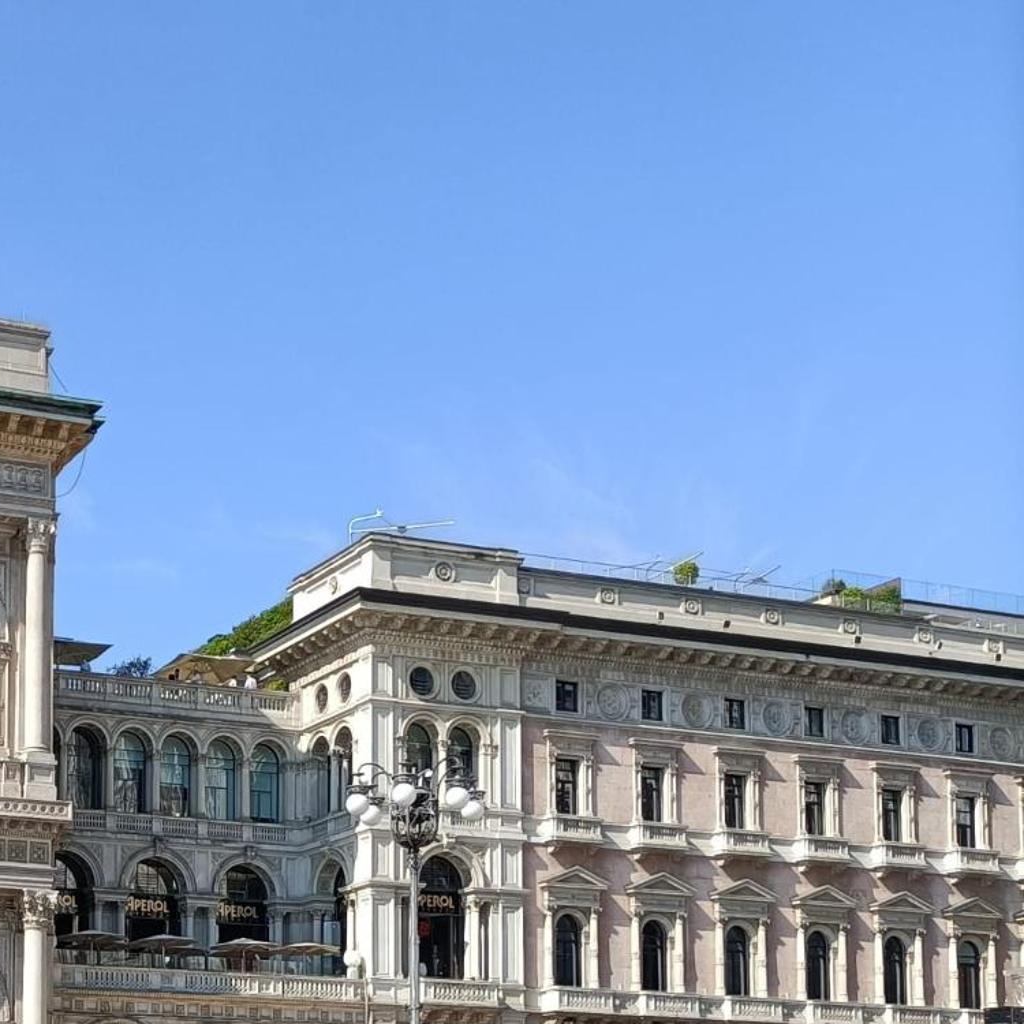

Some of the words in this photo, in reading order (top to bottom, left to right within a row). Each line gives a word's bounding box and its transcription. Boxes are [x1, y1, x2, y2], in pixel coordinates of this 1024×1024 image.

[126, 896, 170, 913] APEROL
[418, 895, 455, 908] PEROL
[217, 902, 260, 919] APEROL
